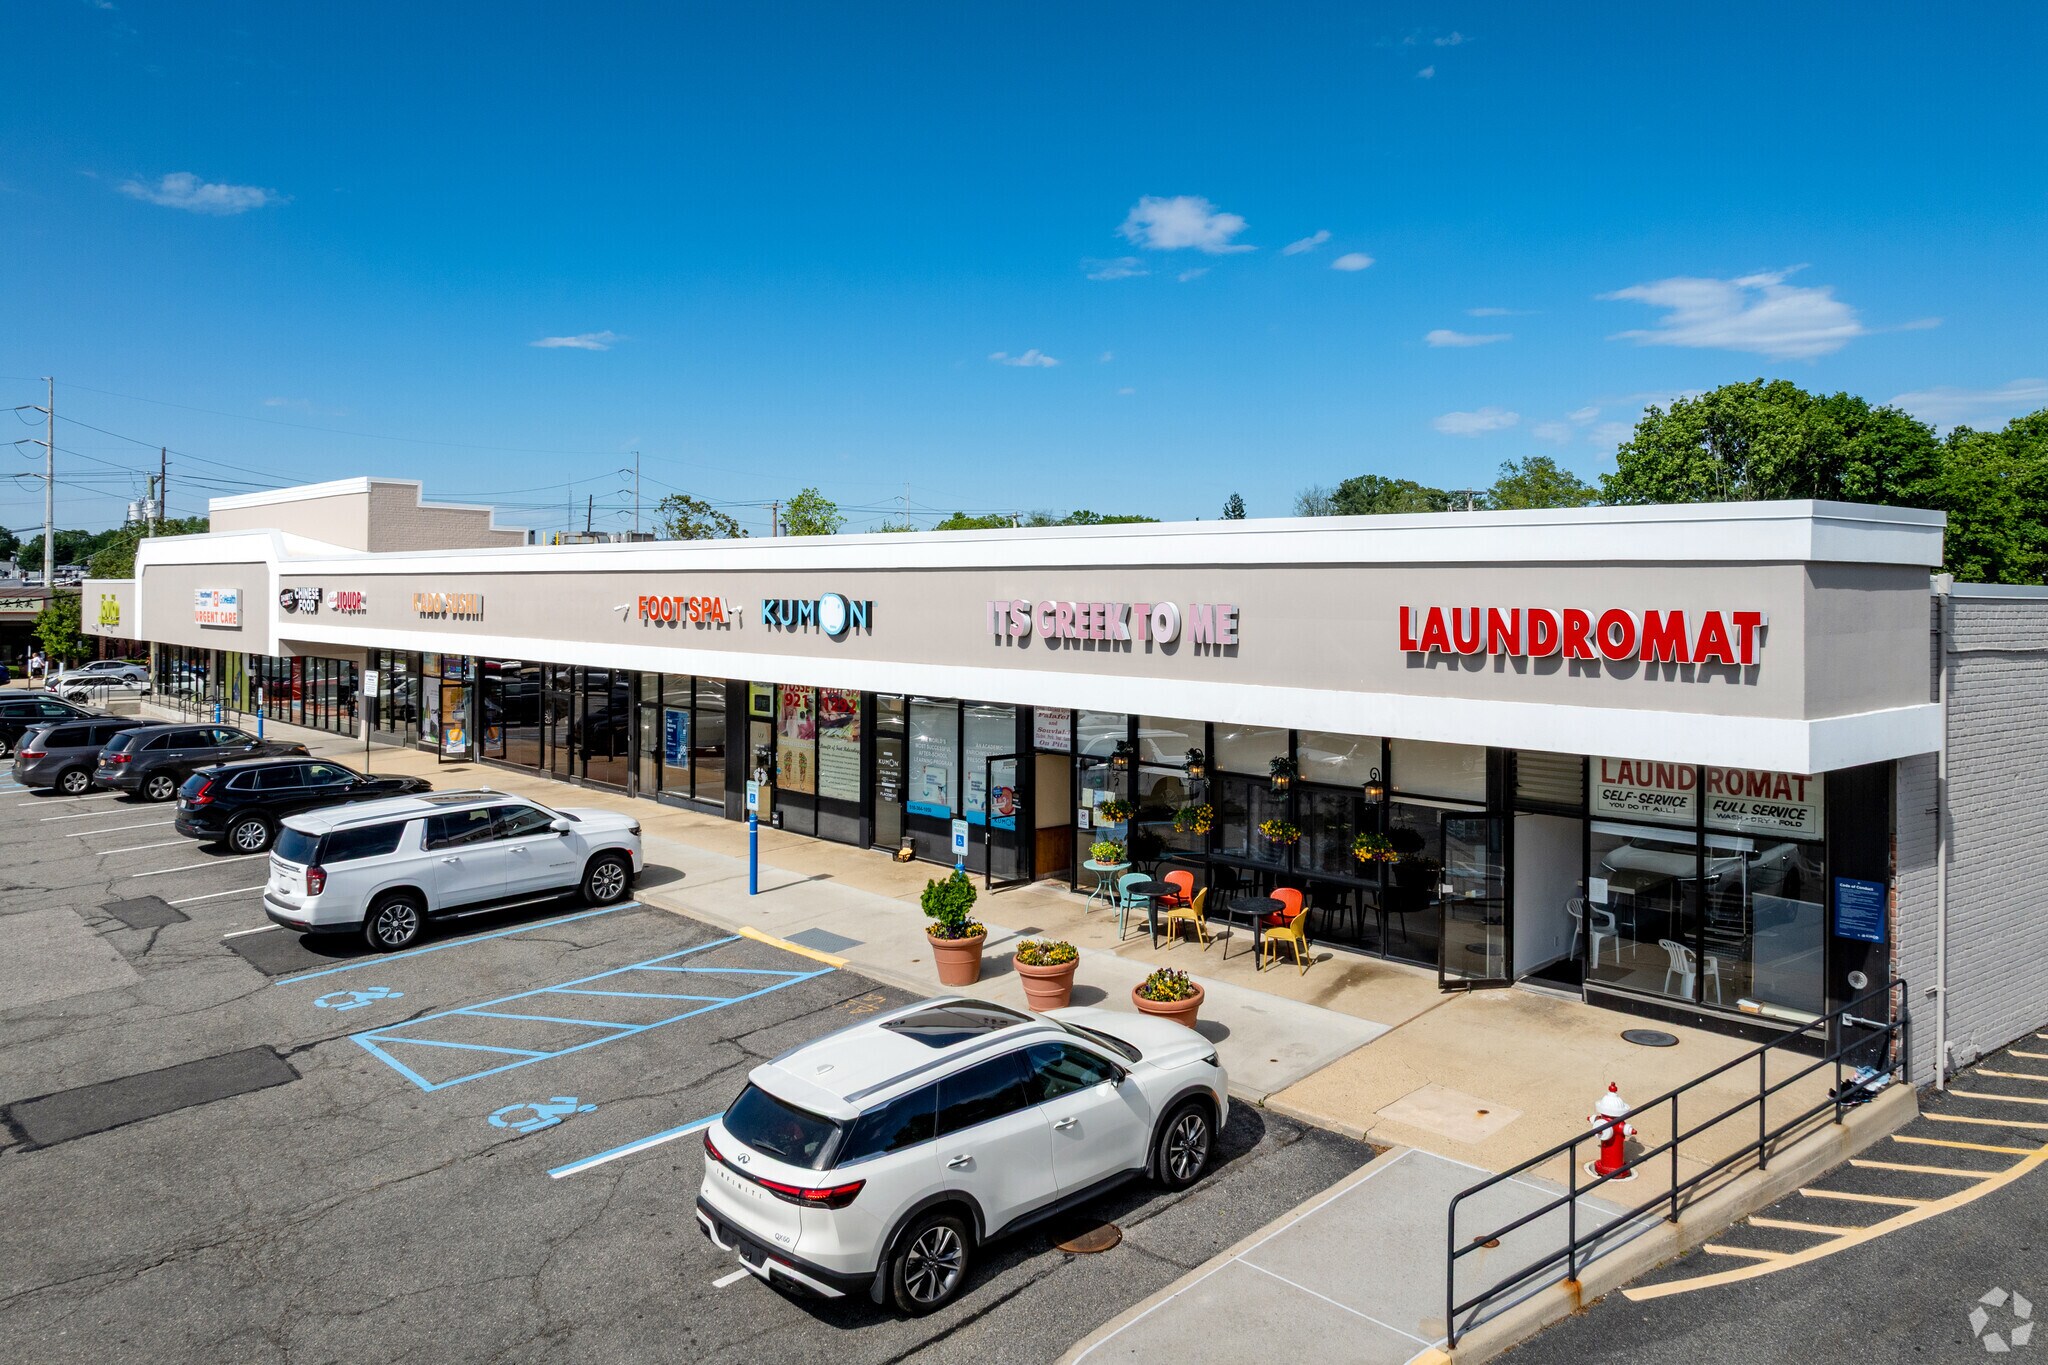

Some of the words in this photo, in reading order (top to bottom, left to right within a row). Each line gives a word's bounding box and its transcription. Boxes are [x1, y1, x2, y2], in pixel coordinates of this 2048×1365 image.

[295, 588, 319, 599] CHINESE
[337, 592, 361, 609] LIQUOR
[300, 600, 316, 611] FOOD
[413, 593, 441, 612] KADO
[446, 593, 478, 614] SUSHI
[638, 595, 684, 622] FOOT
[689, 597, 725, 623] SPA
[195, 611, 218, 623] URGENT
[220, 612, 237, 624] CARE
[761, 592, 868, 635] KUMON
[987, 599, 1031, 637] ITS
[1037, 600, 1131, 640] GREEK
[1134, 601, 1181, 643] TO
[1188, 603, 1238, 645] ME
[1399, 606, 1763, 665] LAUNDROMAT
[823, 697, 857, 715] 1292
[1038, 712, 1070, 720] Falafel
[878, 758, 899, 767] KUMON
[1602, 789, 1687, 808] SELF-SERVICE
[1713, 800, 1748, 814] FULL
[1751, 803, 1807, 820] SERVICE
[994, 818, 1015, 827] KUMON
[1716, 813, 1743, 821] WASH
[1751, 816, 1770, 824] DRY
[1778, 819, 1803, 828] FOLD
[716, 1168, 762, 1199] INFINITI
[774, 1232, 790, 1244] QX60
